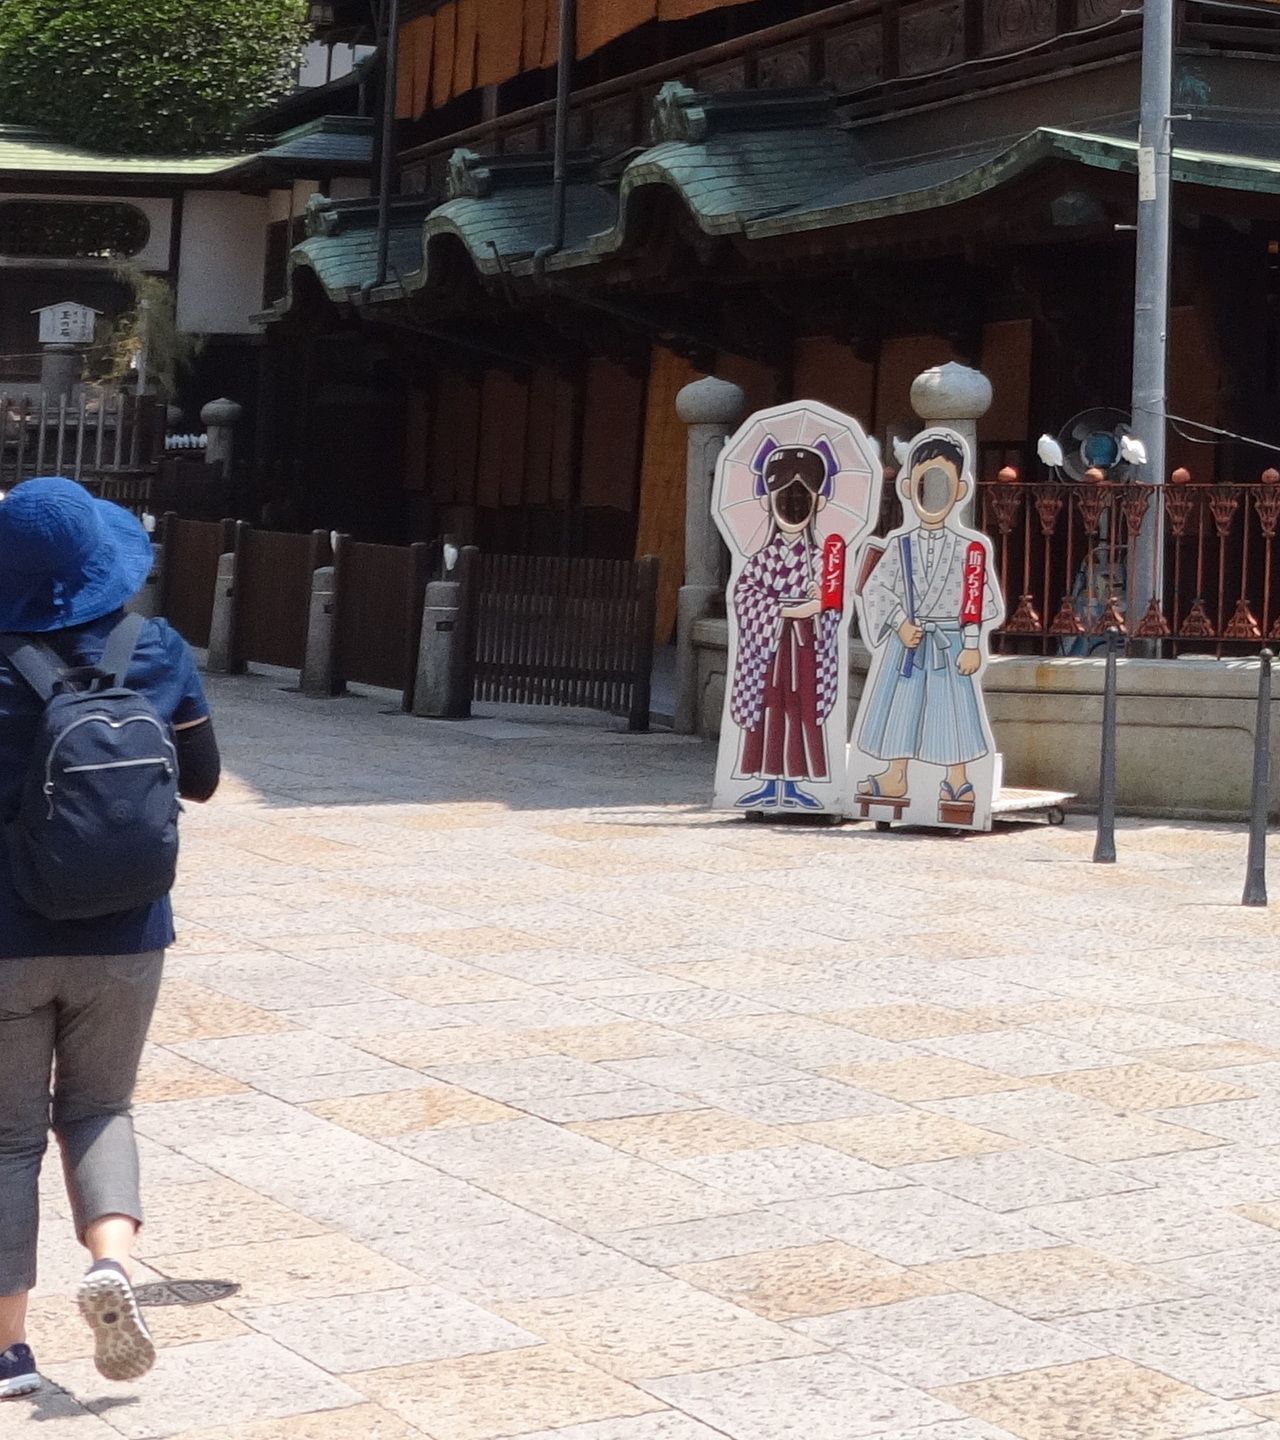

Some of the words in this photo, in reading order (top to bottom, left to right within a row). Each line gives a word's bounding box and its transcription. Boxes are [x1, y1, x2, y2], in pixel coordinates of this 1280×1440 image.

[825, 541, 842, 593] マドンナ
[964, 550, 983, 614] 坊っちゃん
